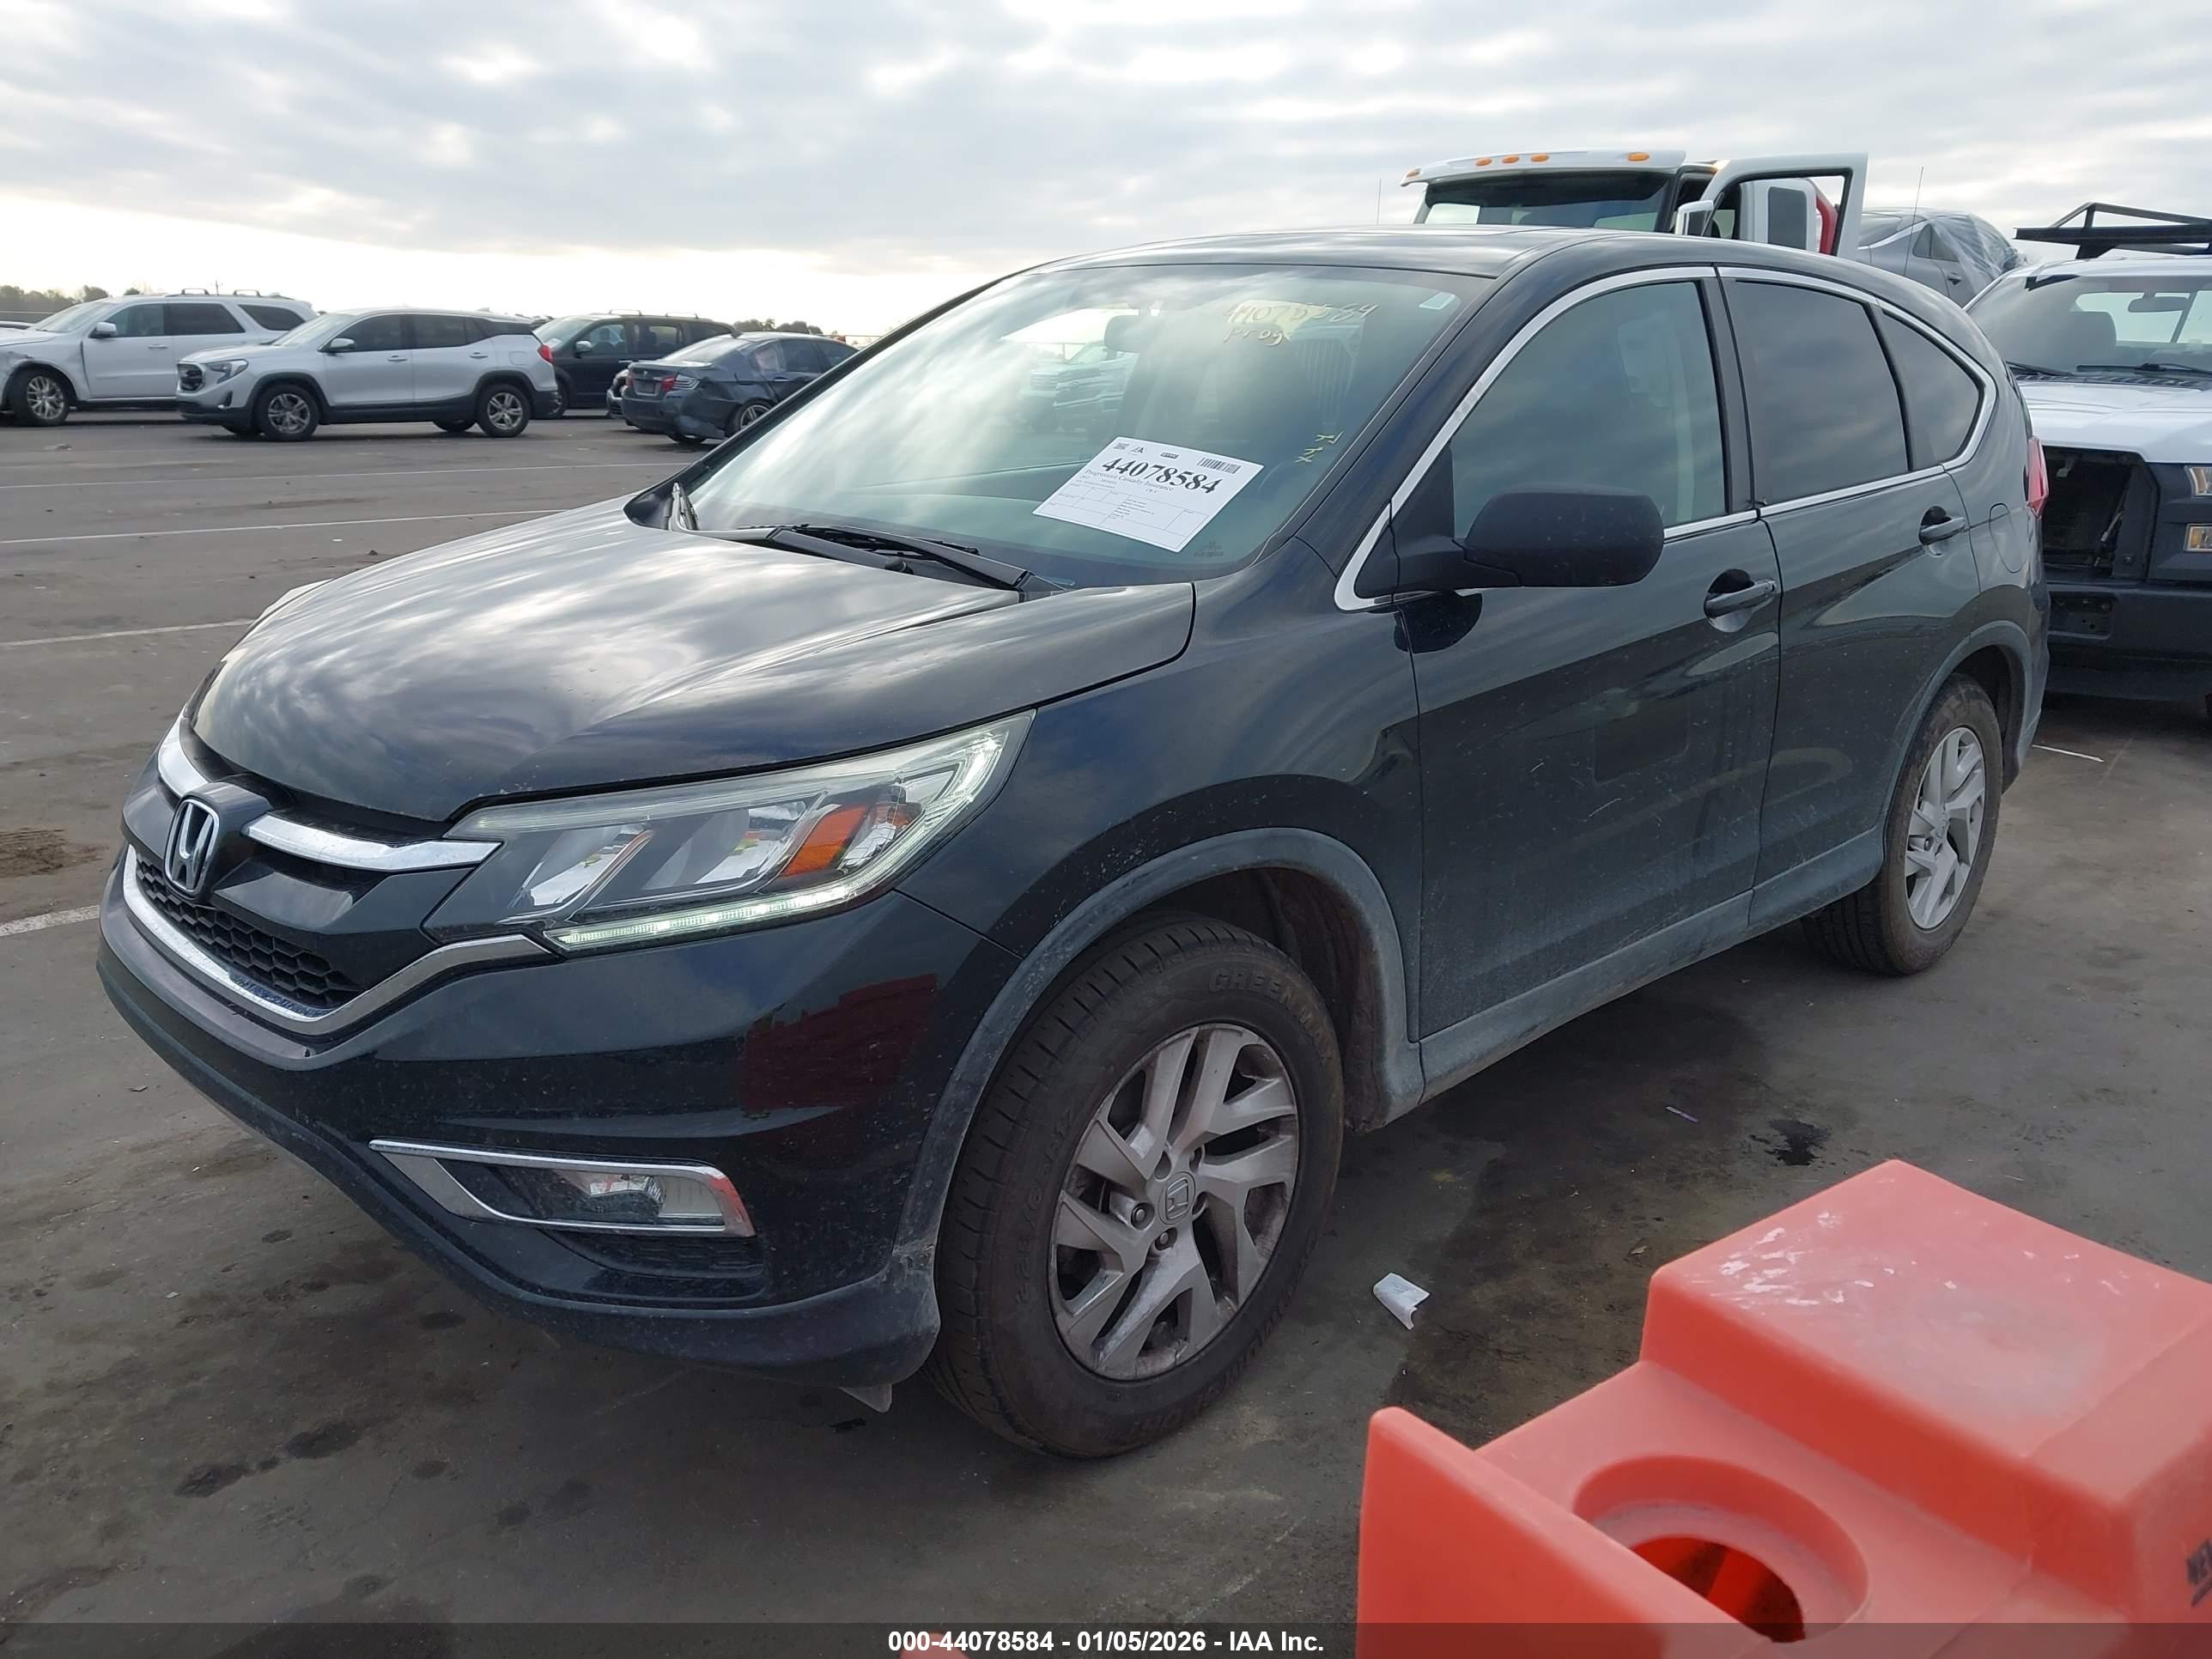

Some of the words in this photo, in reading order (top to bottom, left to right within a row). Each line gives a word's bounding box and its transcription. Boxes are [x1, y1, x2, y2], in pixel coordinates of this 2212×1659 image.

[1103, 457, 1223, 494] 44078584
[1119, 475, 1144, 485] Casualty
[1145, 479, 1175, 491] Insurance
